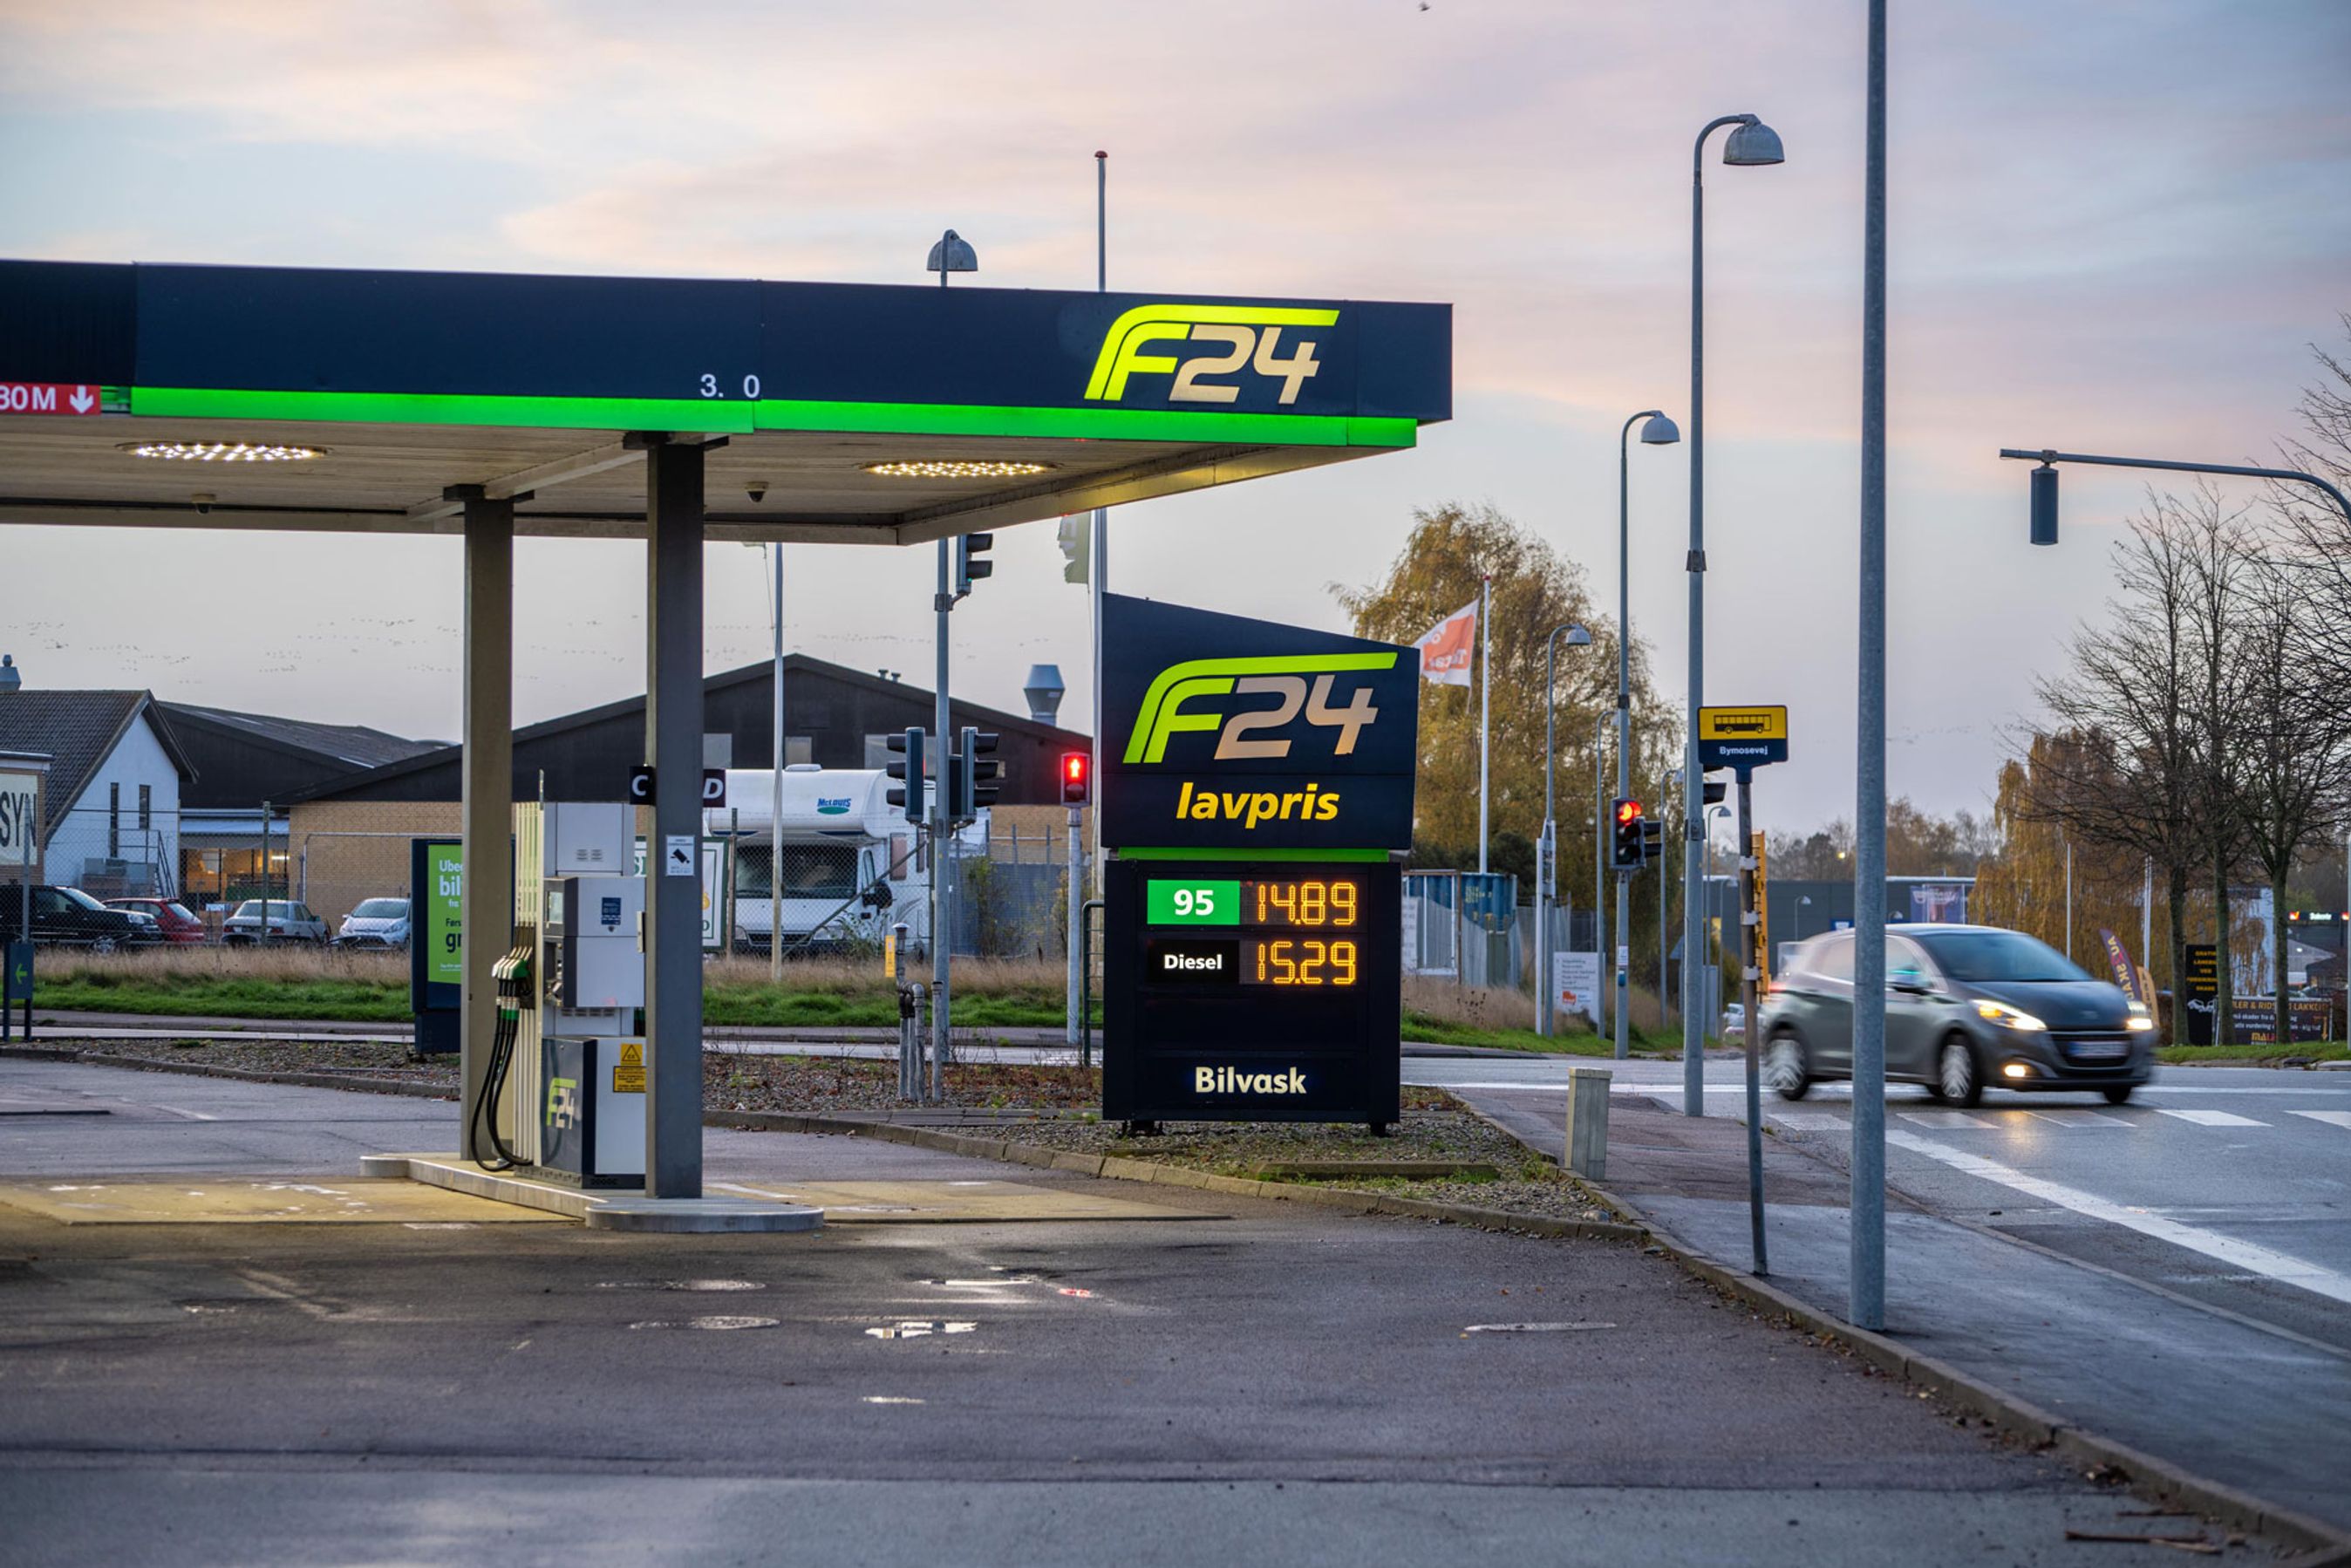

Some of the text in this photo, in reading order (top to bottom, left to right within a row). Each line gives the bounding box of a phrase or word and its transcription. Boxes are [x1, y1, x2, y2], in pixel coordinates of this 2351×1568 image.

[1084, 303, 1340, 405] F24
[1122, 651, 1399, 764] F24
[1719, 746, 1768, 756] Bymosevej
[631, 774, 649, 796] C
[703, 778, 724, 799] D
[1176, 782, 1340, 829] lavpris
[1174, 882, 1357, 926] 95 14.89
[1163, 941, 1357, 985] Diesel 15.29
[1195, 1066, 1307, 1094] Bilvask
[547, 1078, 576, 1130] F24
